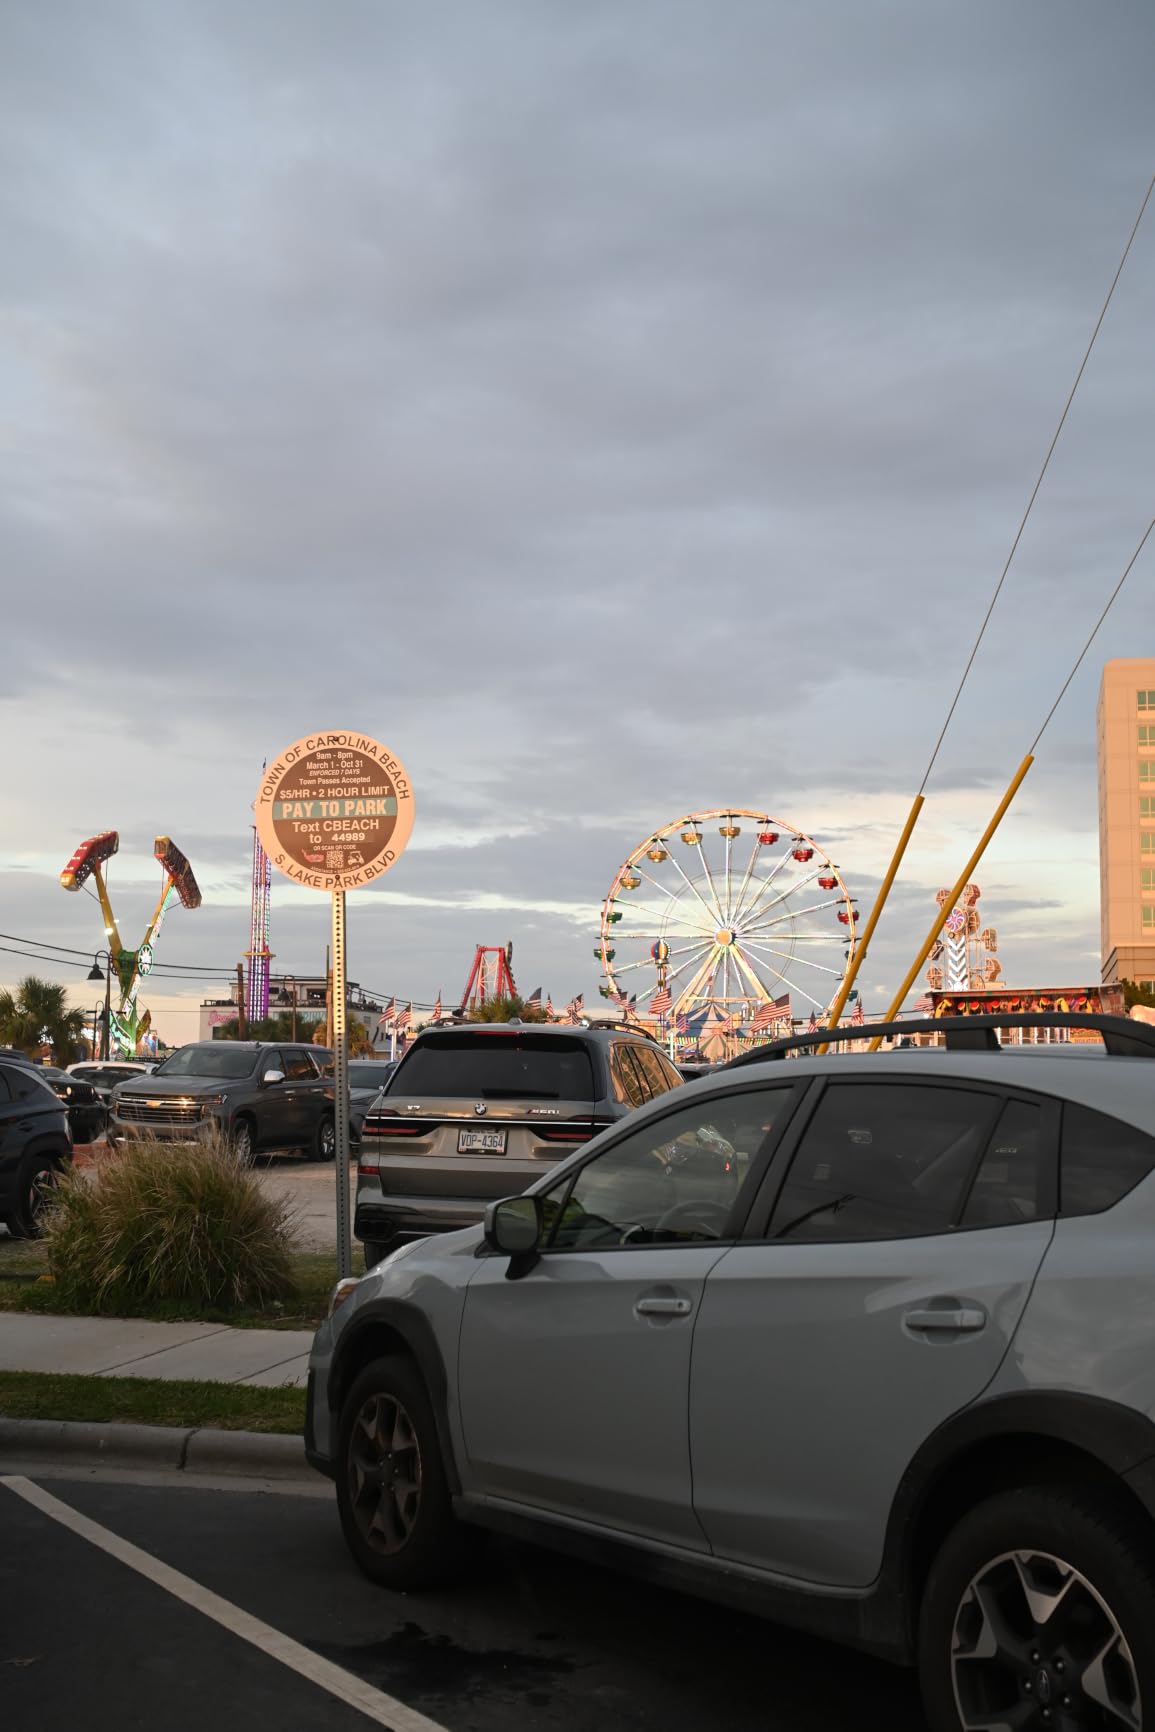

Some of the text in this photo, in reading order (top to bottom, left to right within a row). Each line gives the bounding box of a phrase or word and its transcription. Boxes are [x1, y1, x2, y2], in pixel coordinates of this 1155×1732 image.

[316, 752, 332, 760] 9am
[337, 751, 353, 761] 8pm
[260, 735, 410, 804] TOWN OF CAROLINA BEACH
[306, 761, 329, 770] March
[340, 760, 354, 769] Oct
[355, 760, 364, 768] 31
[309, 769, 340, 777] ENFORCED
[299, 776, 371, 786] Town Passes Accepted
[318, 788, 325, 797] 2
[327, 787, 359, 797] HOUR
[361, 786, 390, 796] LIMIT
[282, 799, 387, 818] PAY TO PARK
[292, 818, 380, 833] Text CBEACH
[309, 832, 366, 844] to 44989
[275, 854, 285, 868] S.
[285, 864, 322, 888] LAKE
[325, 873, 362, 889] PARK
[365, 850, 396, 879] BLVD
